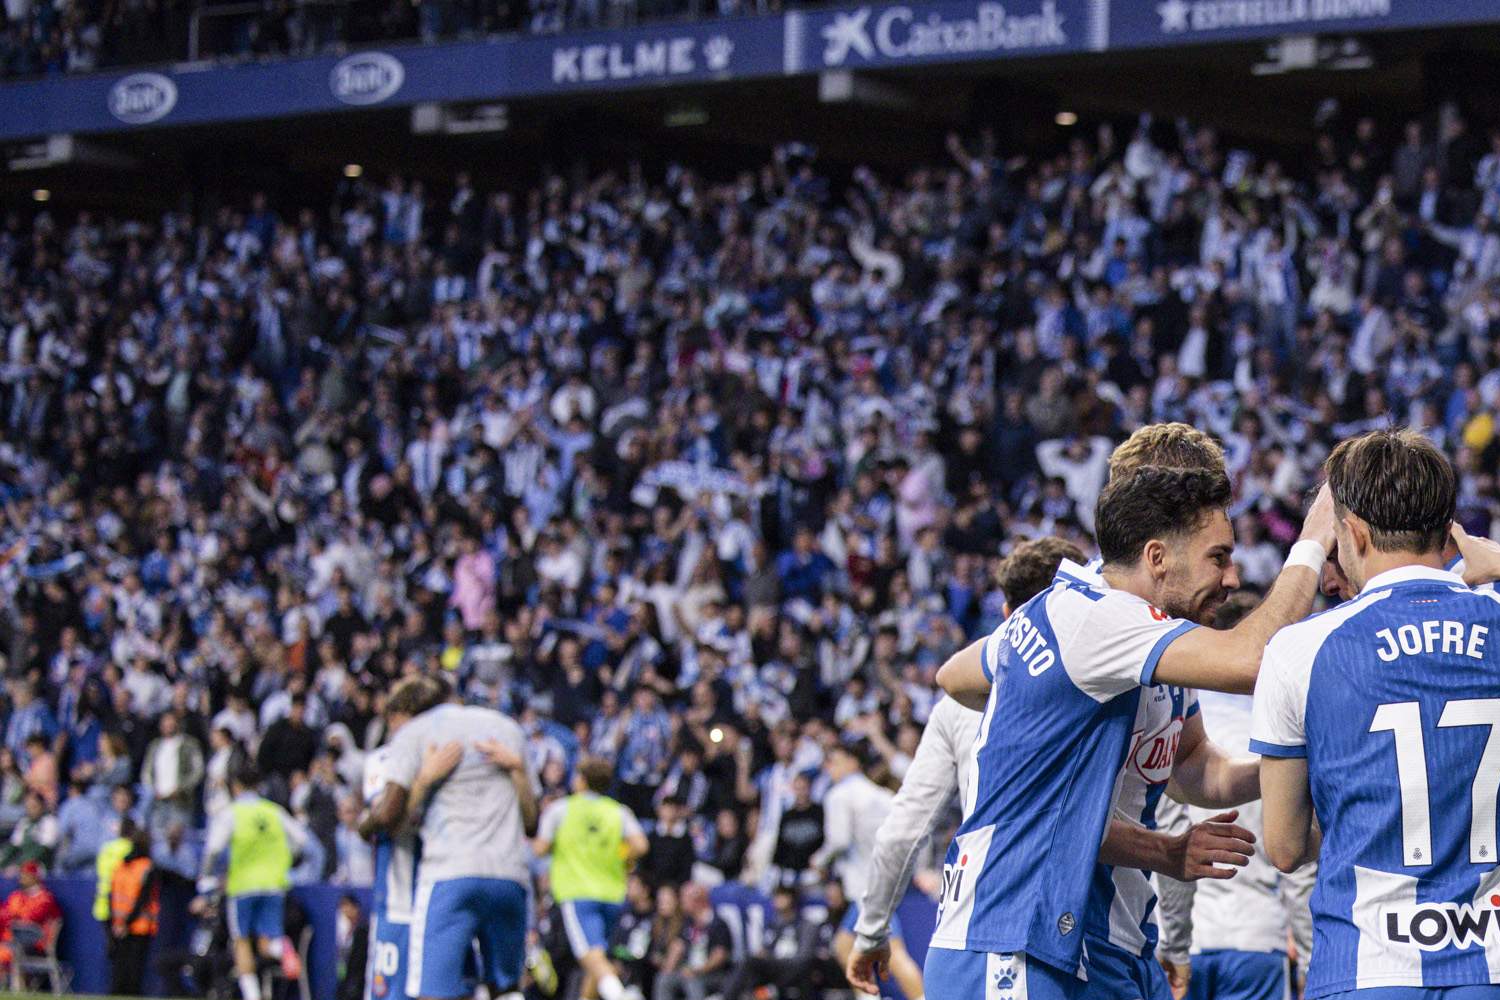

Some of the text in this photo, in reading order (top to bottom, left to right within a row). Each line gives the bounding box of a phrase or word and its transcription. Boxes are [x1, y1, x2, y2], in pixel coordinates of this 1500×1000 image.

[875, 0, 1066, 58] CaixaBank
[553, 36, 696, 84] KELME
[1005, 610, 1056, 677] SITO
[1375, 620, 1489, 662] JOFRE
